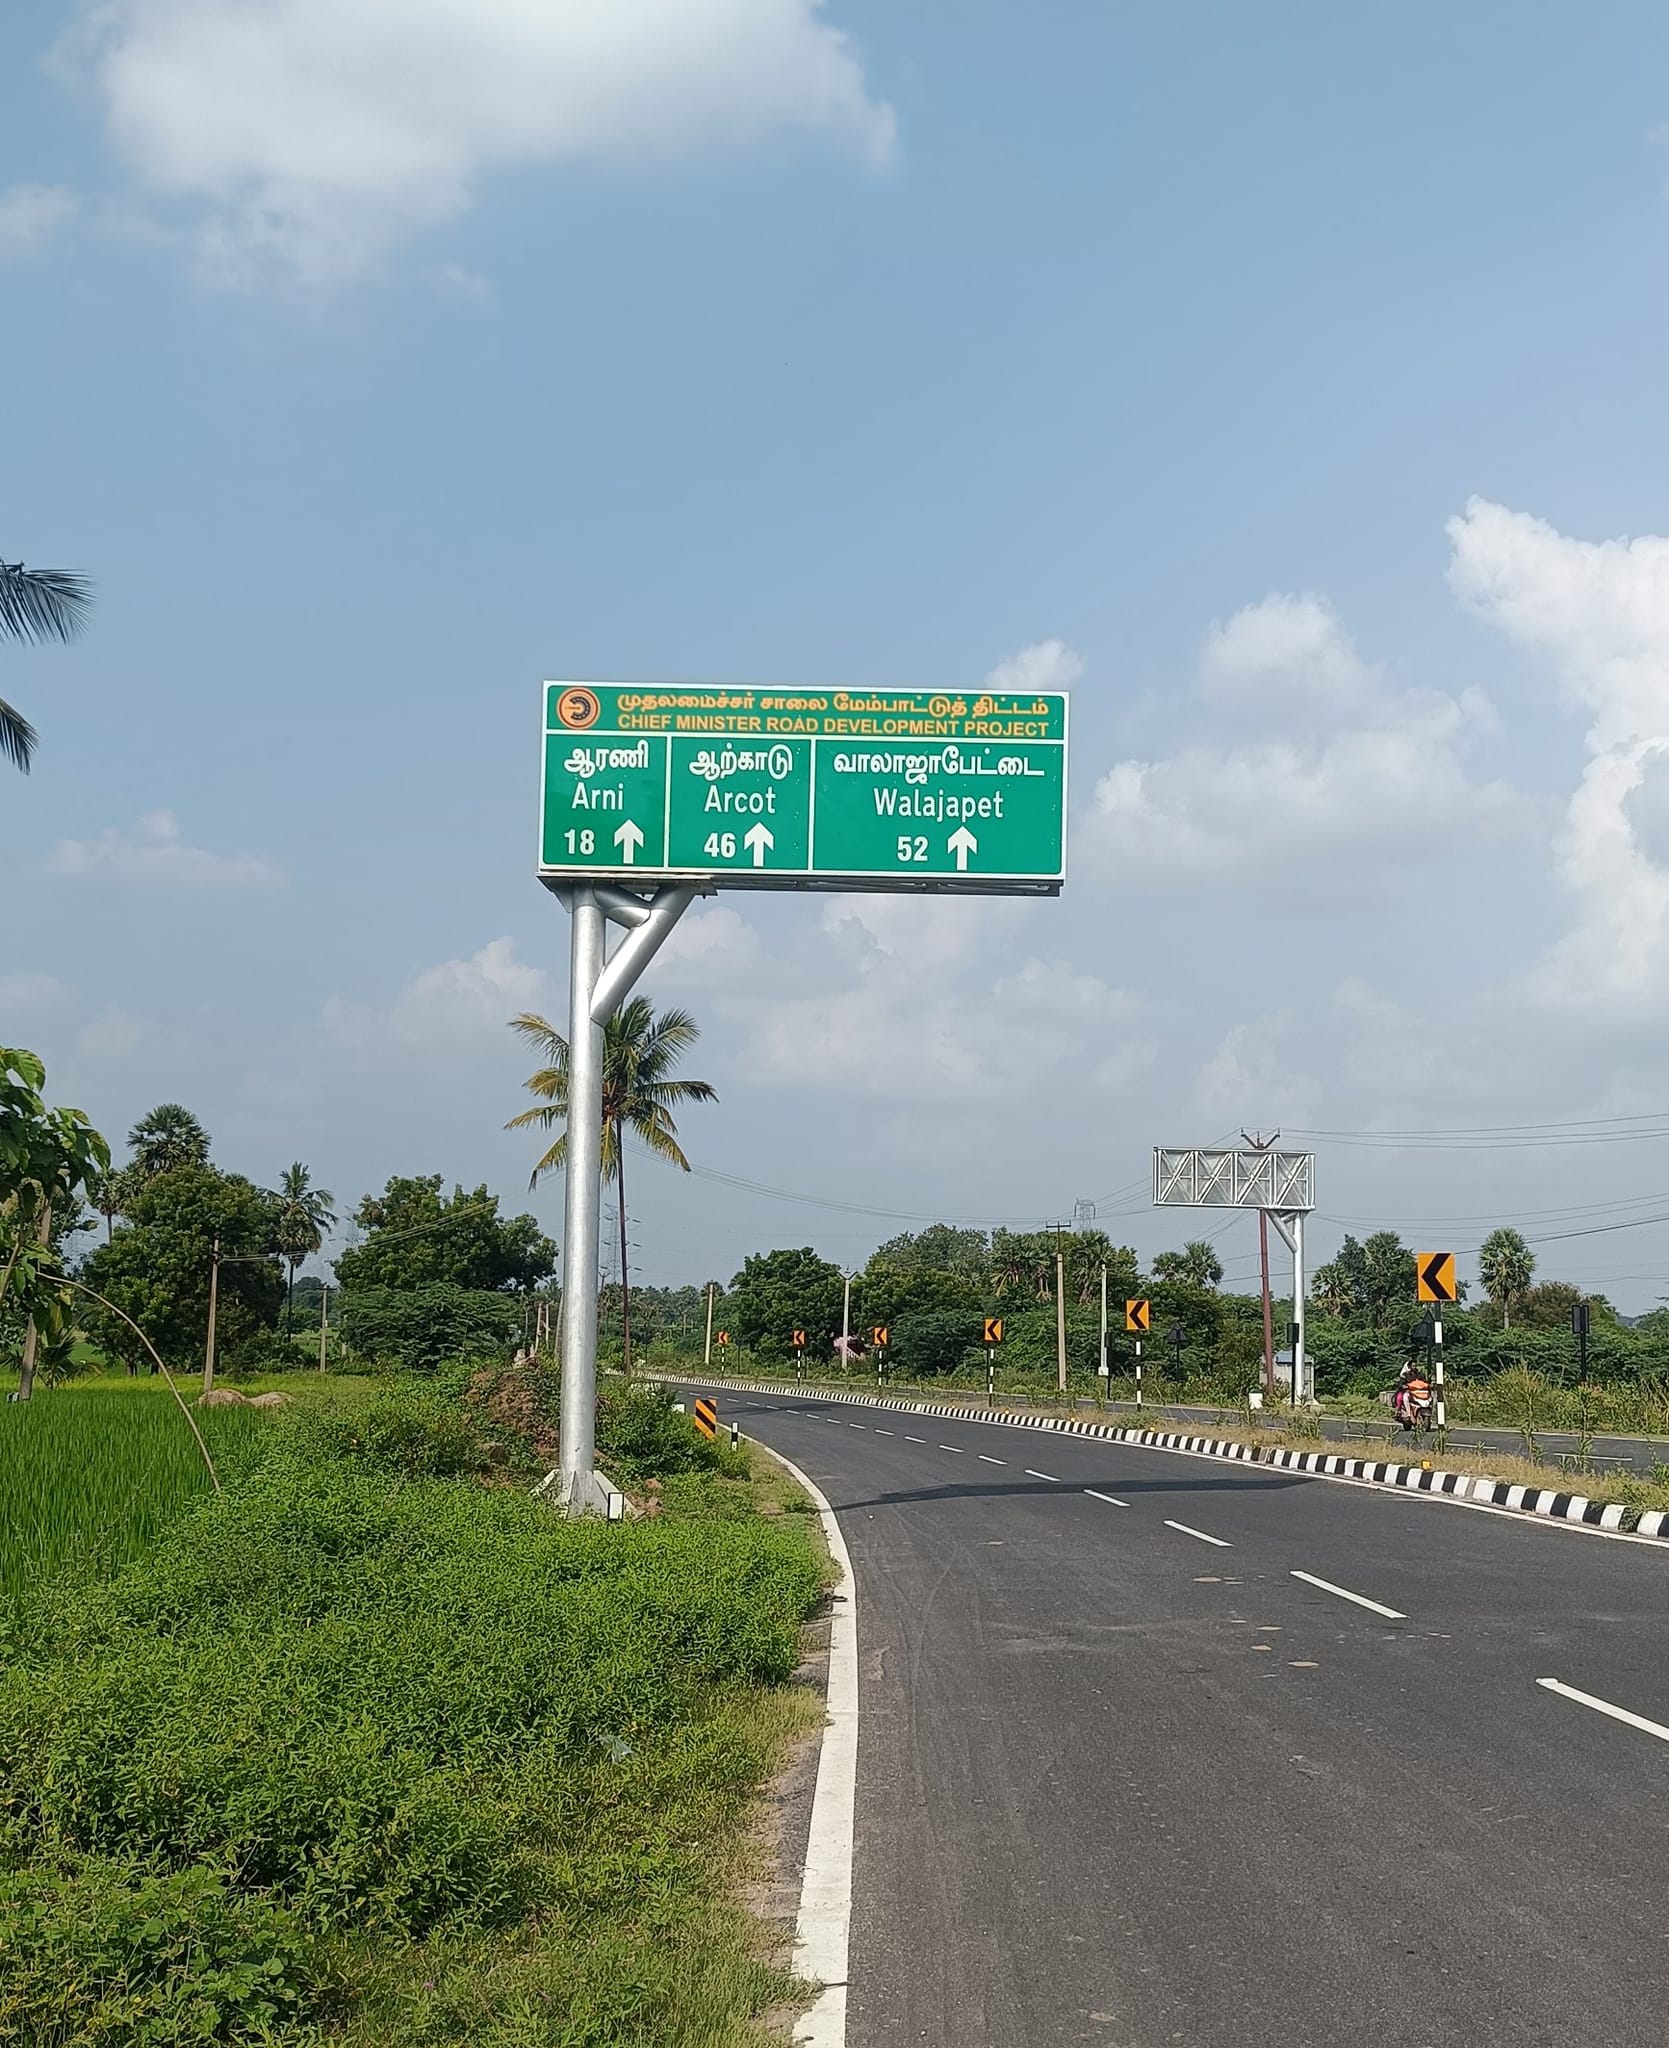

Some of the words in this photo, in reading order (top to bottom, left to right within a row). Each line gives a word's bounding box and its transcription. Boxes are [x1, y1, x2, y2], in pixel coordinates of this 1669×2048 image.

[617, 691, 755, 713] முதலமைச்சர்
[760, 697, 828, 713] சாலை
[833, 692, 967, 718] மேம்பாட்டுத்
[972, 695, 1049, 719] திட்டம்
[618, 714, 671, 731] CHIEF
[676, 716, 762, 733] MINISTER
[766, 717, 818, 733] ROAD
[823, 718, 959, 735] DEVELOPMENT
[964, 721, 1049, 737] PROJECT
[564, 739, 649, 779] ஆரணி
[689, 742, 793, 781] ஆற்காடு
[834, 745, 1045, 785] வாலாஜாபேட்டை
[571, 782, 624, 810] Arni
[704, 784, 777, 814] Arcot
[873, 788, 1004, 823] Walajapet
[563, 829, 596, 855] 18
[703, 832, 737, 859] 46
[897, 836, 929, 862] 52
